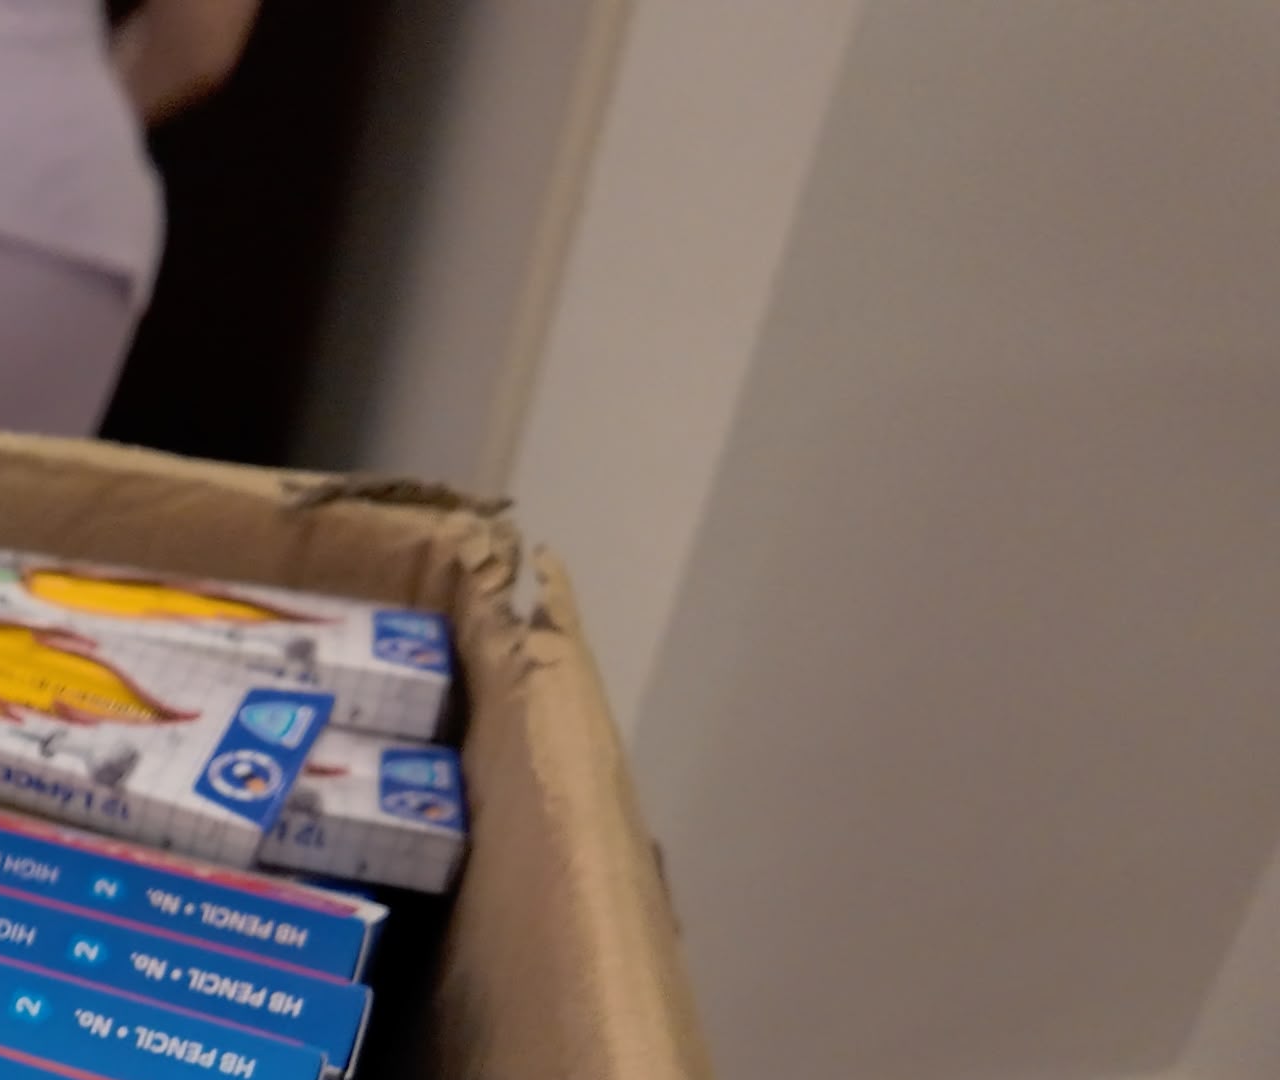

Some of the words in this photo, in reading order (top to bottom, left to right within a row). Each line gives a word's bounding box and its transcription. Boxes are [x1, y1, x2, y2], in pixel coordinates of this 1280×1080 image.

[1, 853, 61, 884] HIGH
[141, 887, 183, 915] No.
[193, 901, 274, 940] PENCIL
[272, 921, 309, 949] HB
[72, 939, 99, 961] 2
[125, 949, 167, 980] No.
[183, 966, 267, 1008] PENCIL
[12, 993, 43, 1017] 2
[266, 989, 304, 1019] HB
[70, 1006, 114, 1037] No.
[130, 1024, 218, 1069] PENCIL
[217, 1050, 257, 1080] HB
